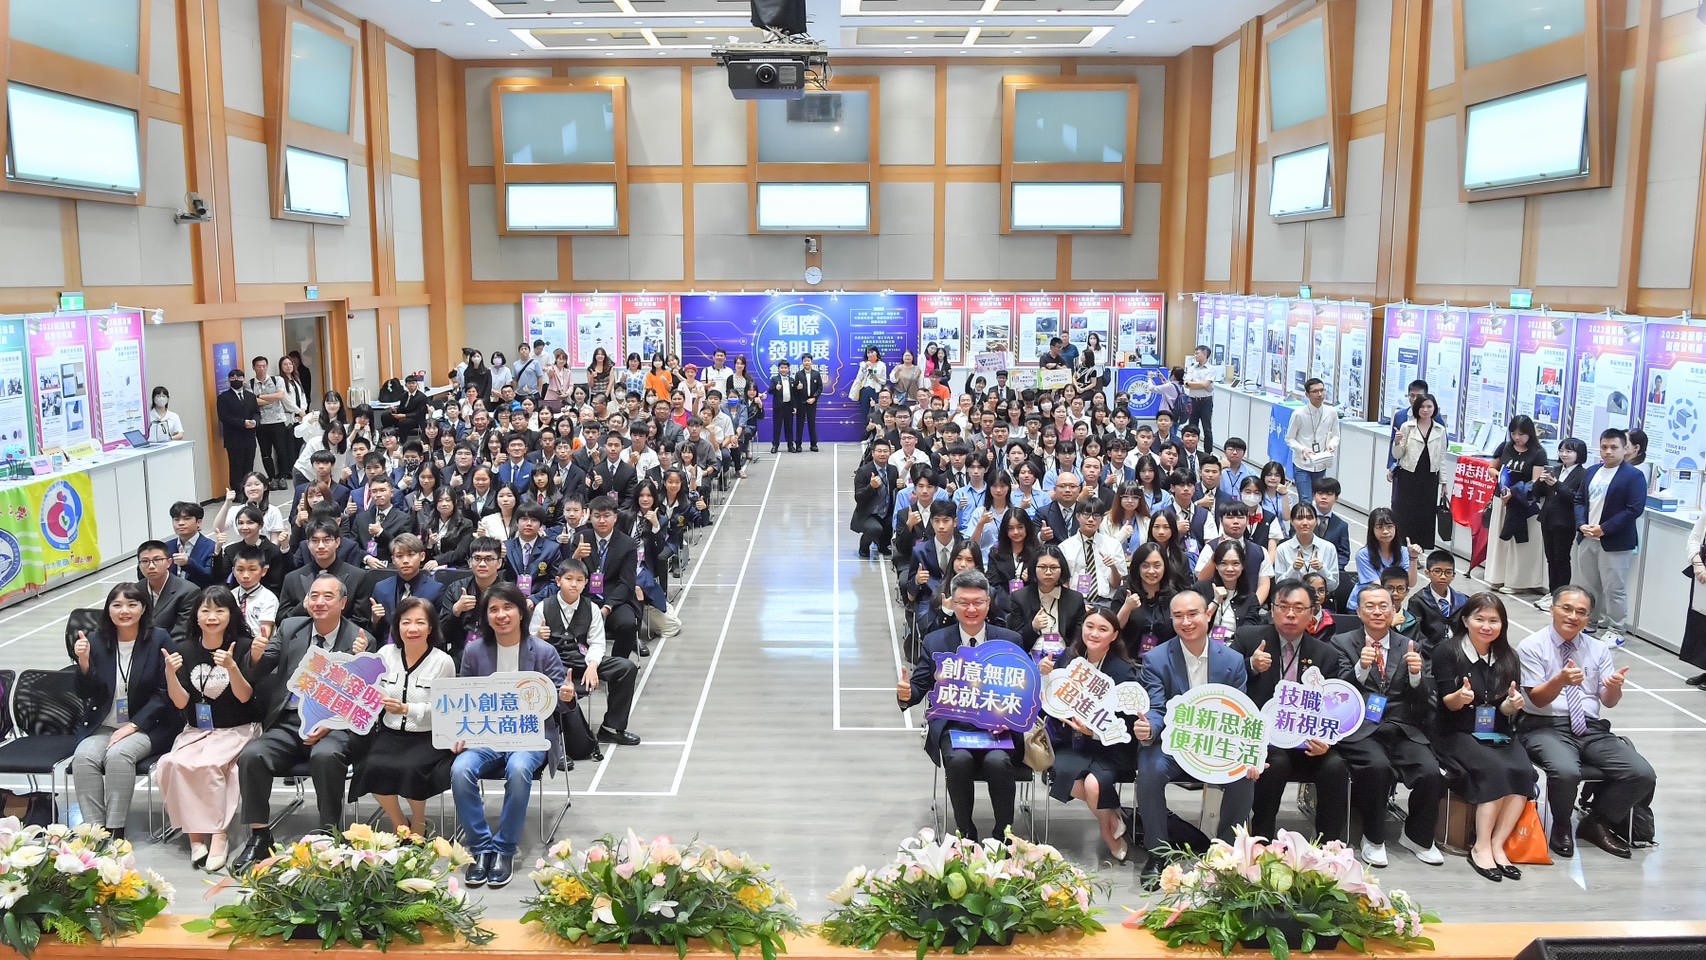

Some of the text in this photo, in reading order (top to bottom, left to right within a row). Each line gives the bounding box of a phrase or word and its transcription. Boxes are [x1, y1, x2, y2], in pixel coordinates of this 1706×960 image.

[778, 315, 820, 336] 國際
[768, 340, 830, 361] 發明展
[306, 652, 385, 711] 臺灣發明
[939, 657, 1026, 690] 創意無限
[1068, 662, 1110, 700] 技職
[293, 671, 373, 730] 榮耀國際
[435, 692, 519, 714] 小小創意
[936, 683, 1023, 715] 成就未來
[1053, 681, 1112, 732] 超進化
[1278, 685, 1322, 712] 技職
[455, 714, 539, 736] 大大商機
[1172, 703, 1264, 741] 創新思維
[1274, 709, 1339, 740] 新視界
[1169, 727, 1260, 766] 便利生活
